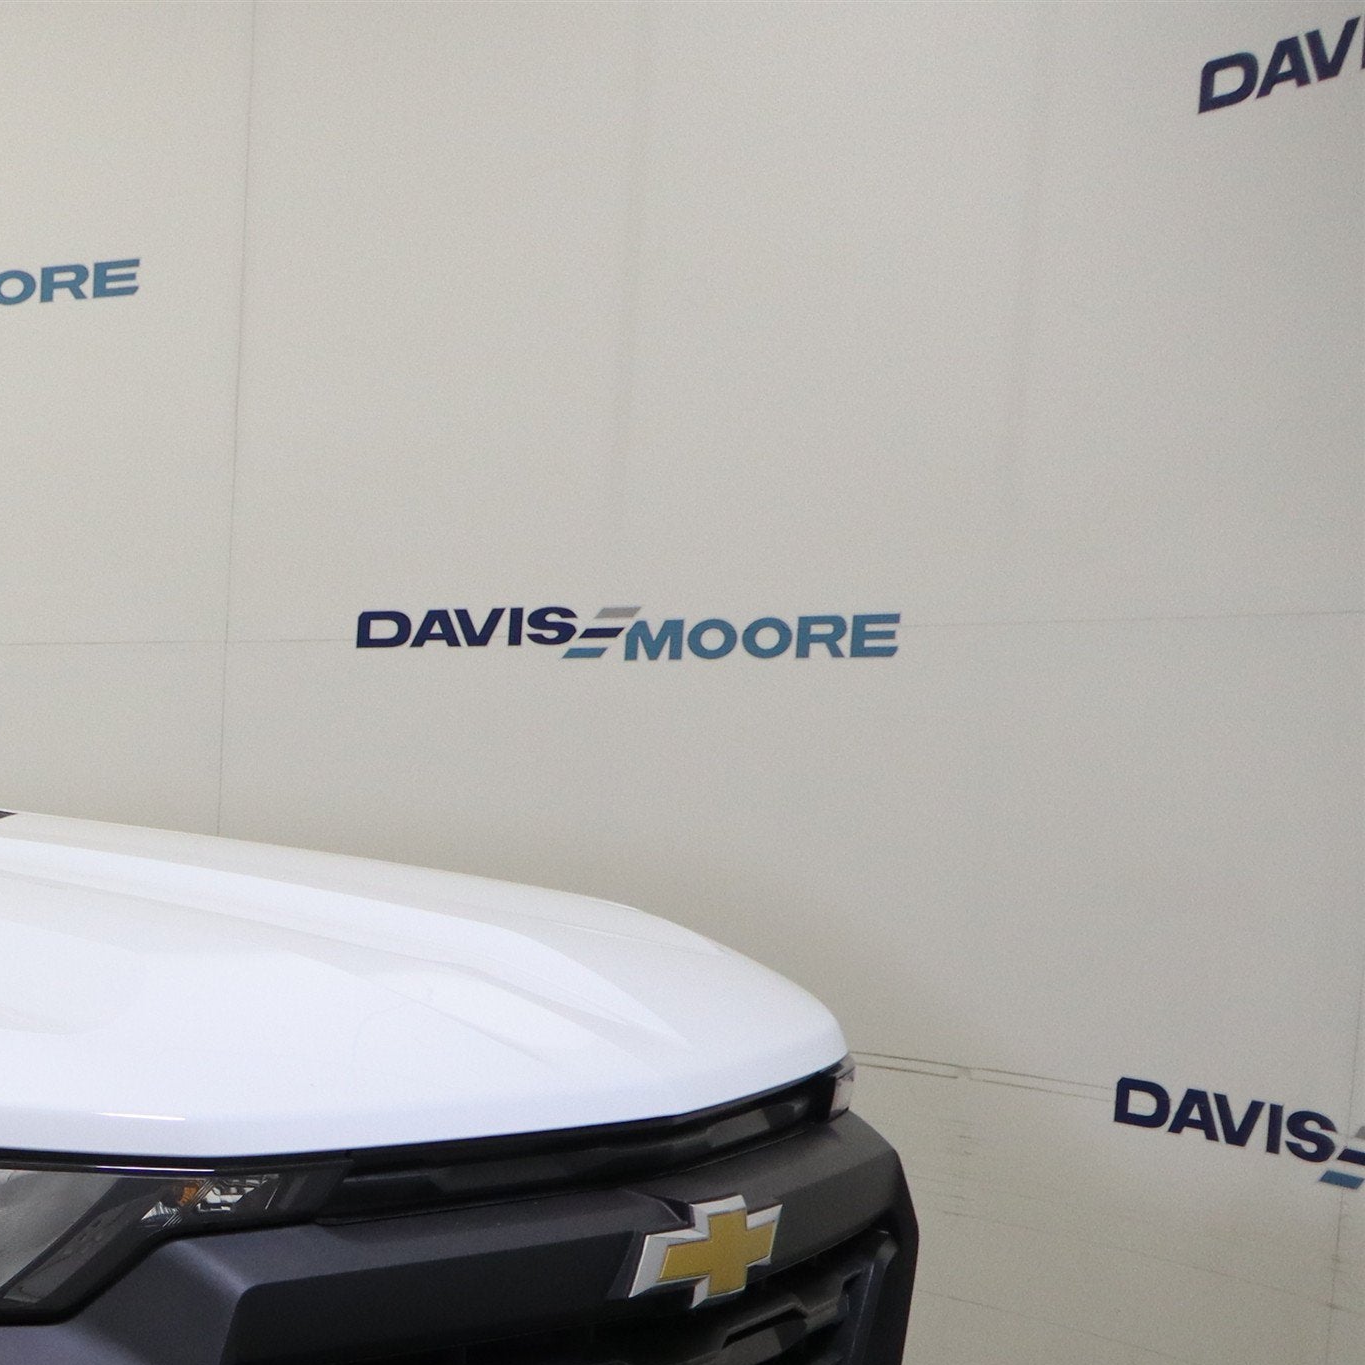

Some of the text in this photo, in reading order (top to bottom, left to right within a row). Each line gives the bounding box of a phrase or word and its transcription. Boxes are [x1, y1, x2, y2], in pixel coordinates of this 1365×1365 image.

[1198, 14, 1365, 114] DAV
[356, 606, 901, 661] DAVIS MOORE
[1114, 1076, 1338, 1163] DAVIS
